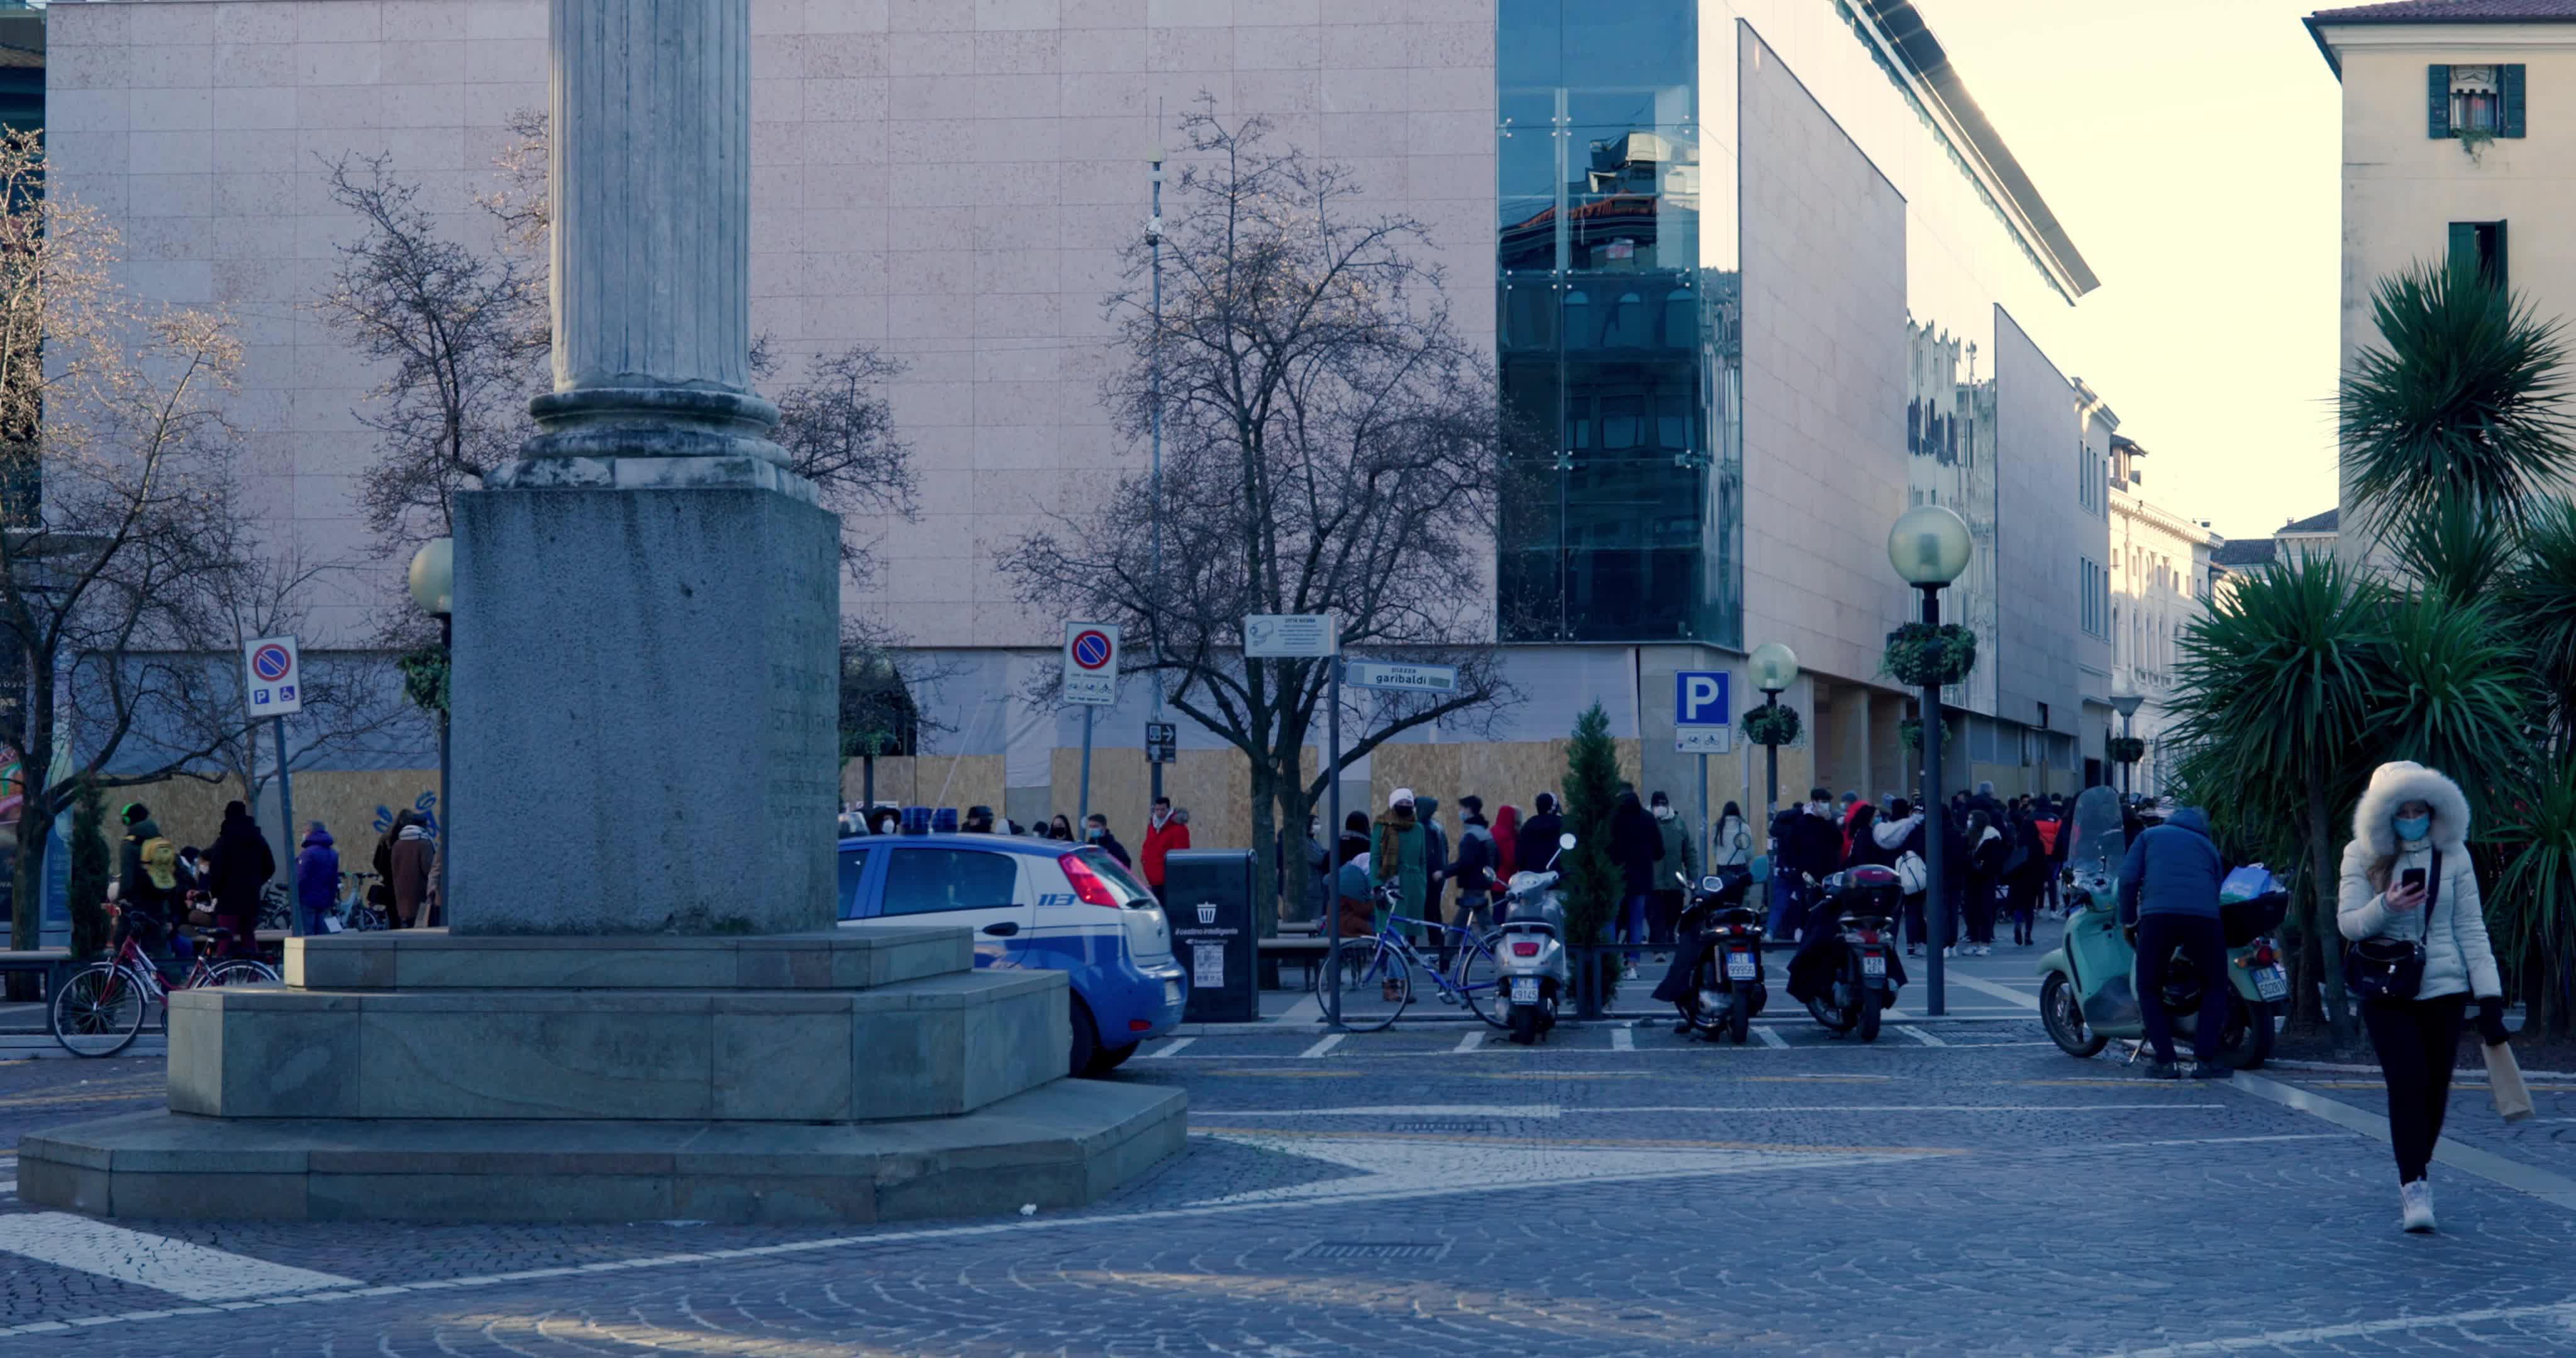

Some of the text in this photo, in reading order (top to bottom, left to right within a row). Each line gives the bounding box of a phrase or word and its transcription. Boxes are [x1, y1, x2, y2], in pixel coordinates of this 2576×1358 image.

[1376, 675, 1426, 685] garibaldi
[257, 691, 267, 703] P
[1687, 676, 1719, 719] P
[1038, 893, 1077, 905] 113
